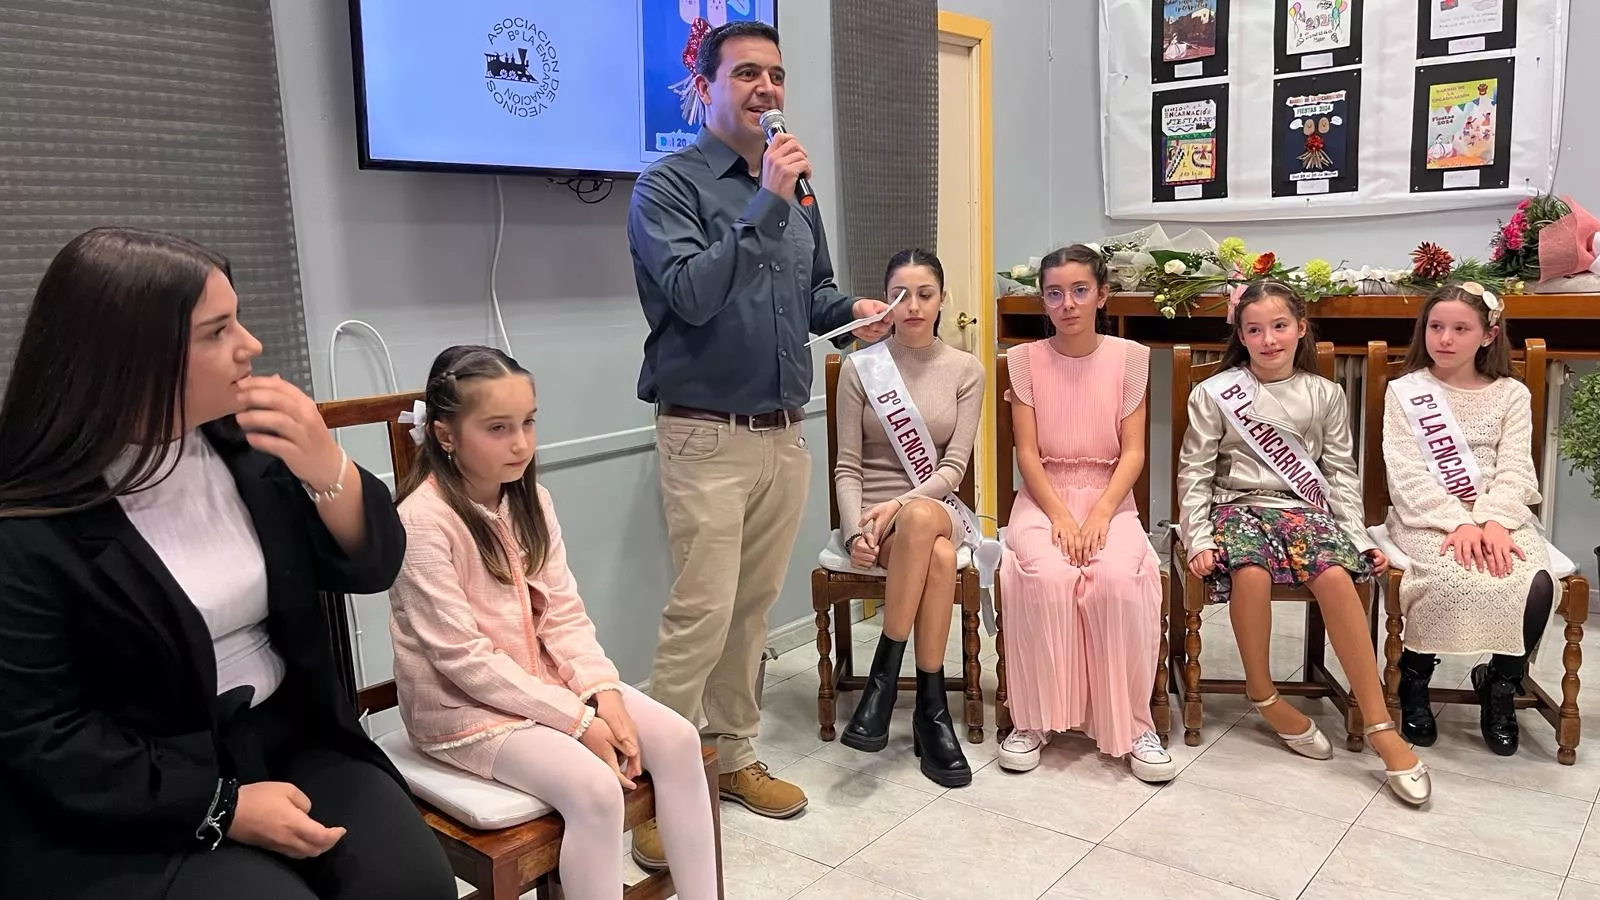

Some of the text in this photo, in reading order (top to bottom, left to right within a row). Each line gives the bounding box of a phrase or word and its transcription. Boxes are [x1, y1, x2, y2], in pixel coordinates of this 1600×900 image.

[522, 30, 535, 46] LA
[486, 17, 560, 118] ASOCIACION DE VECINOS
[886, 407, 912, 432] LA
[1418, 413, 1447, 437] LA
